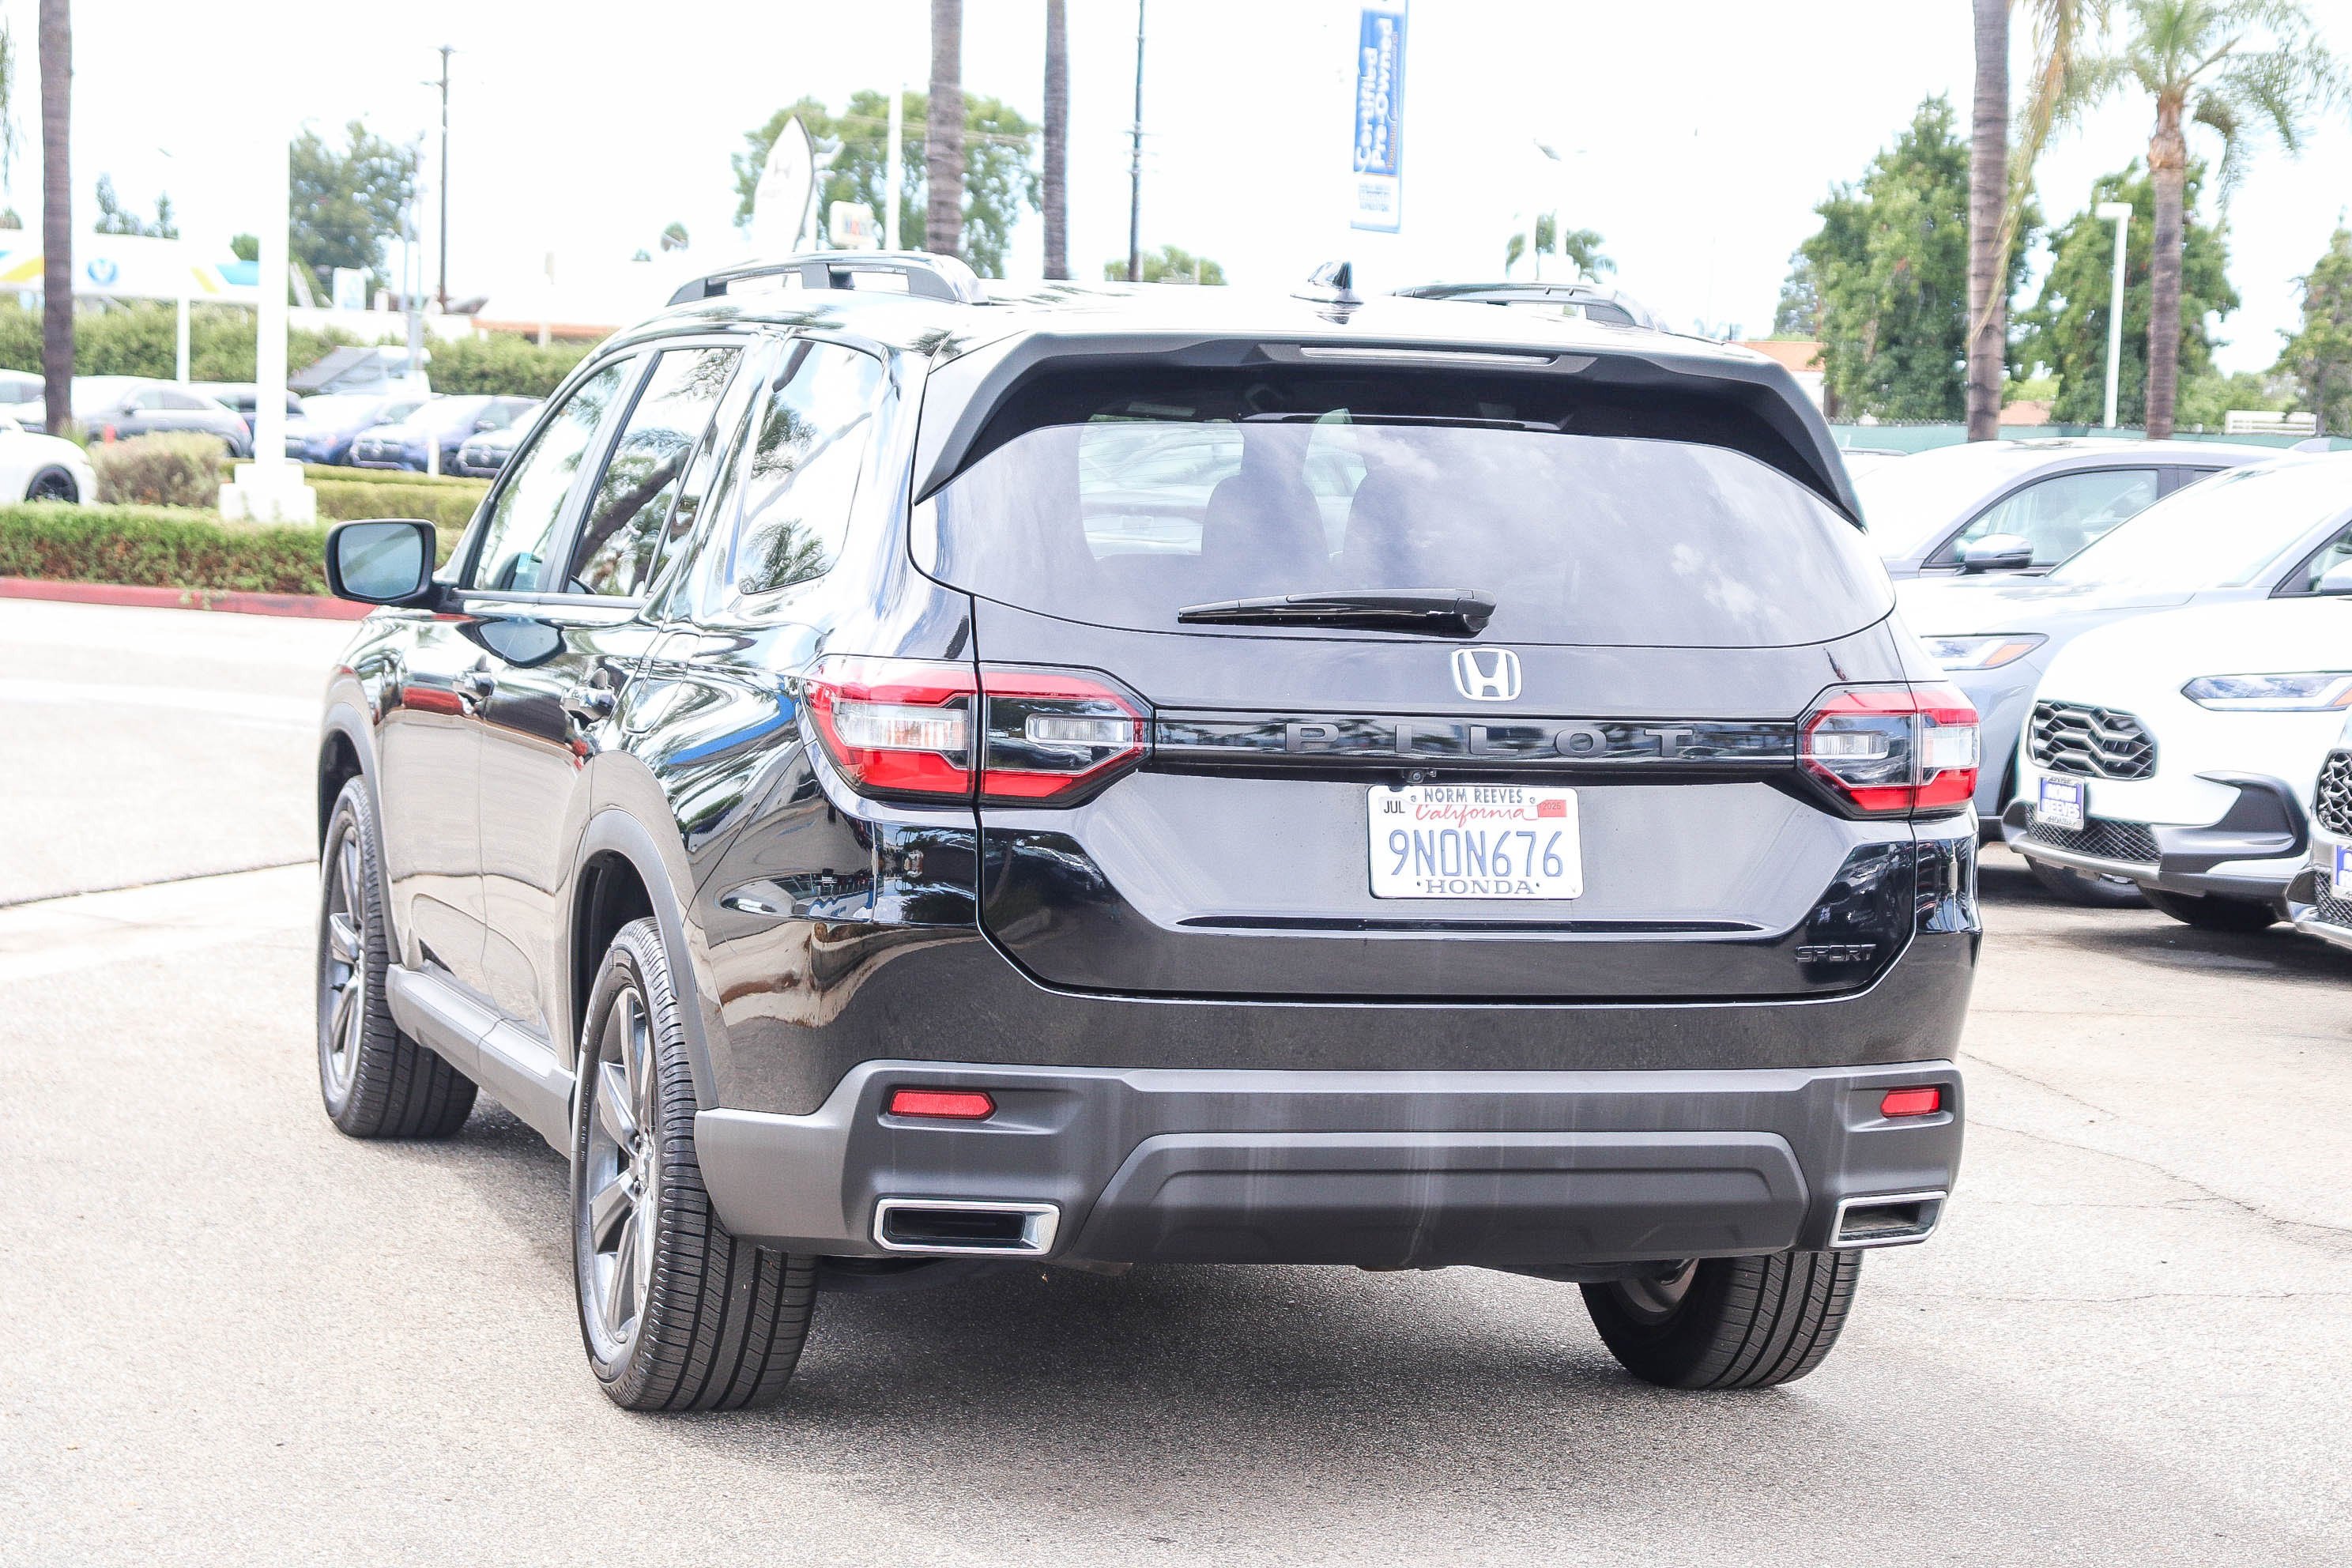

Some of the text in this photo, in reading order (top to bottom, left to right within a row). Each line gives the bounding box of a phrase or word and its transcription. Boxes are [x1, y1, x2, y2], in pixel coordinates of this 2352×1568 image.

[1370, 17, 1393, 168] Pre-Owned
[1284, 722, 1694, 758] PILOT
[1424, 788, 1524, 804] NORM REEVES
[1383, 801, 1406, 814] JUL
[1415, 804, 1539, 828] California
[1389, 829, 1564, 877] 9NON676
[1426, 879, 1536, 895] HONDA
[1795, 944, 1877, 963] SPORT
